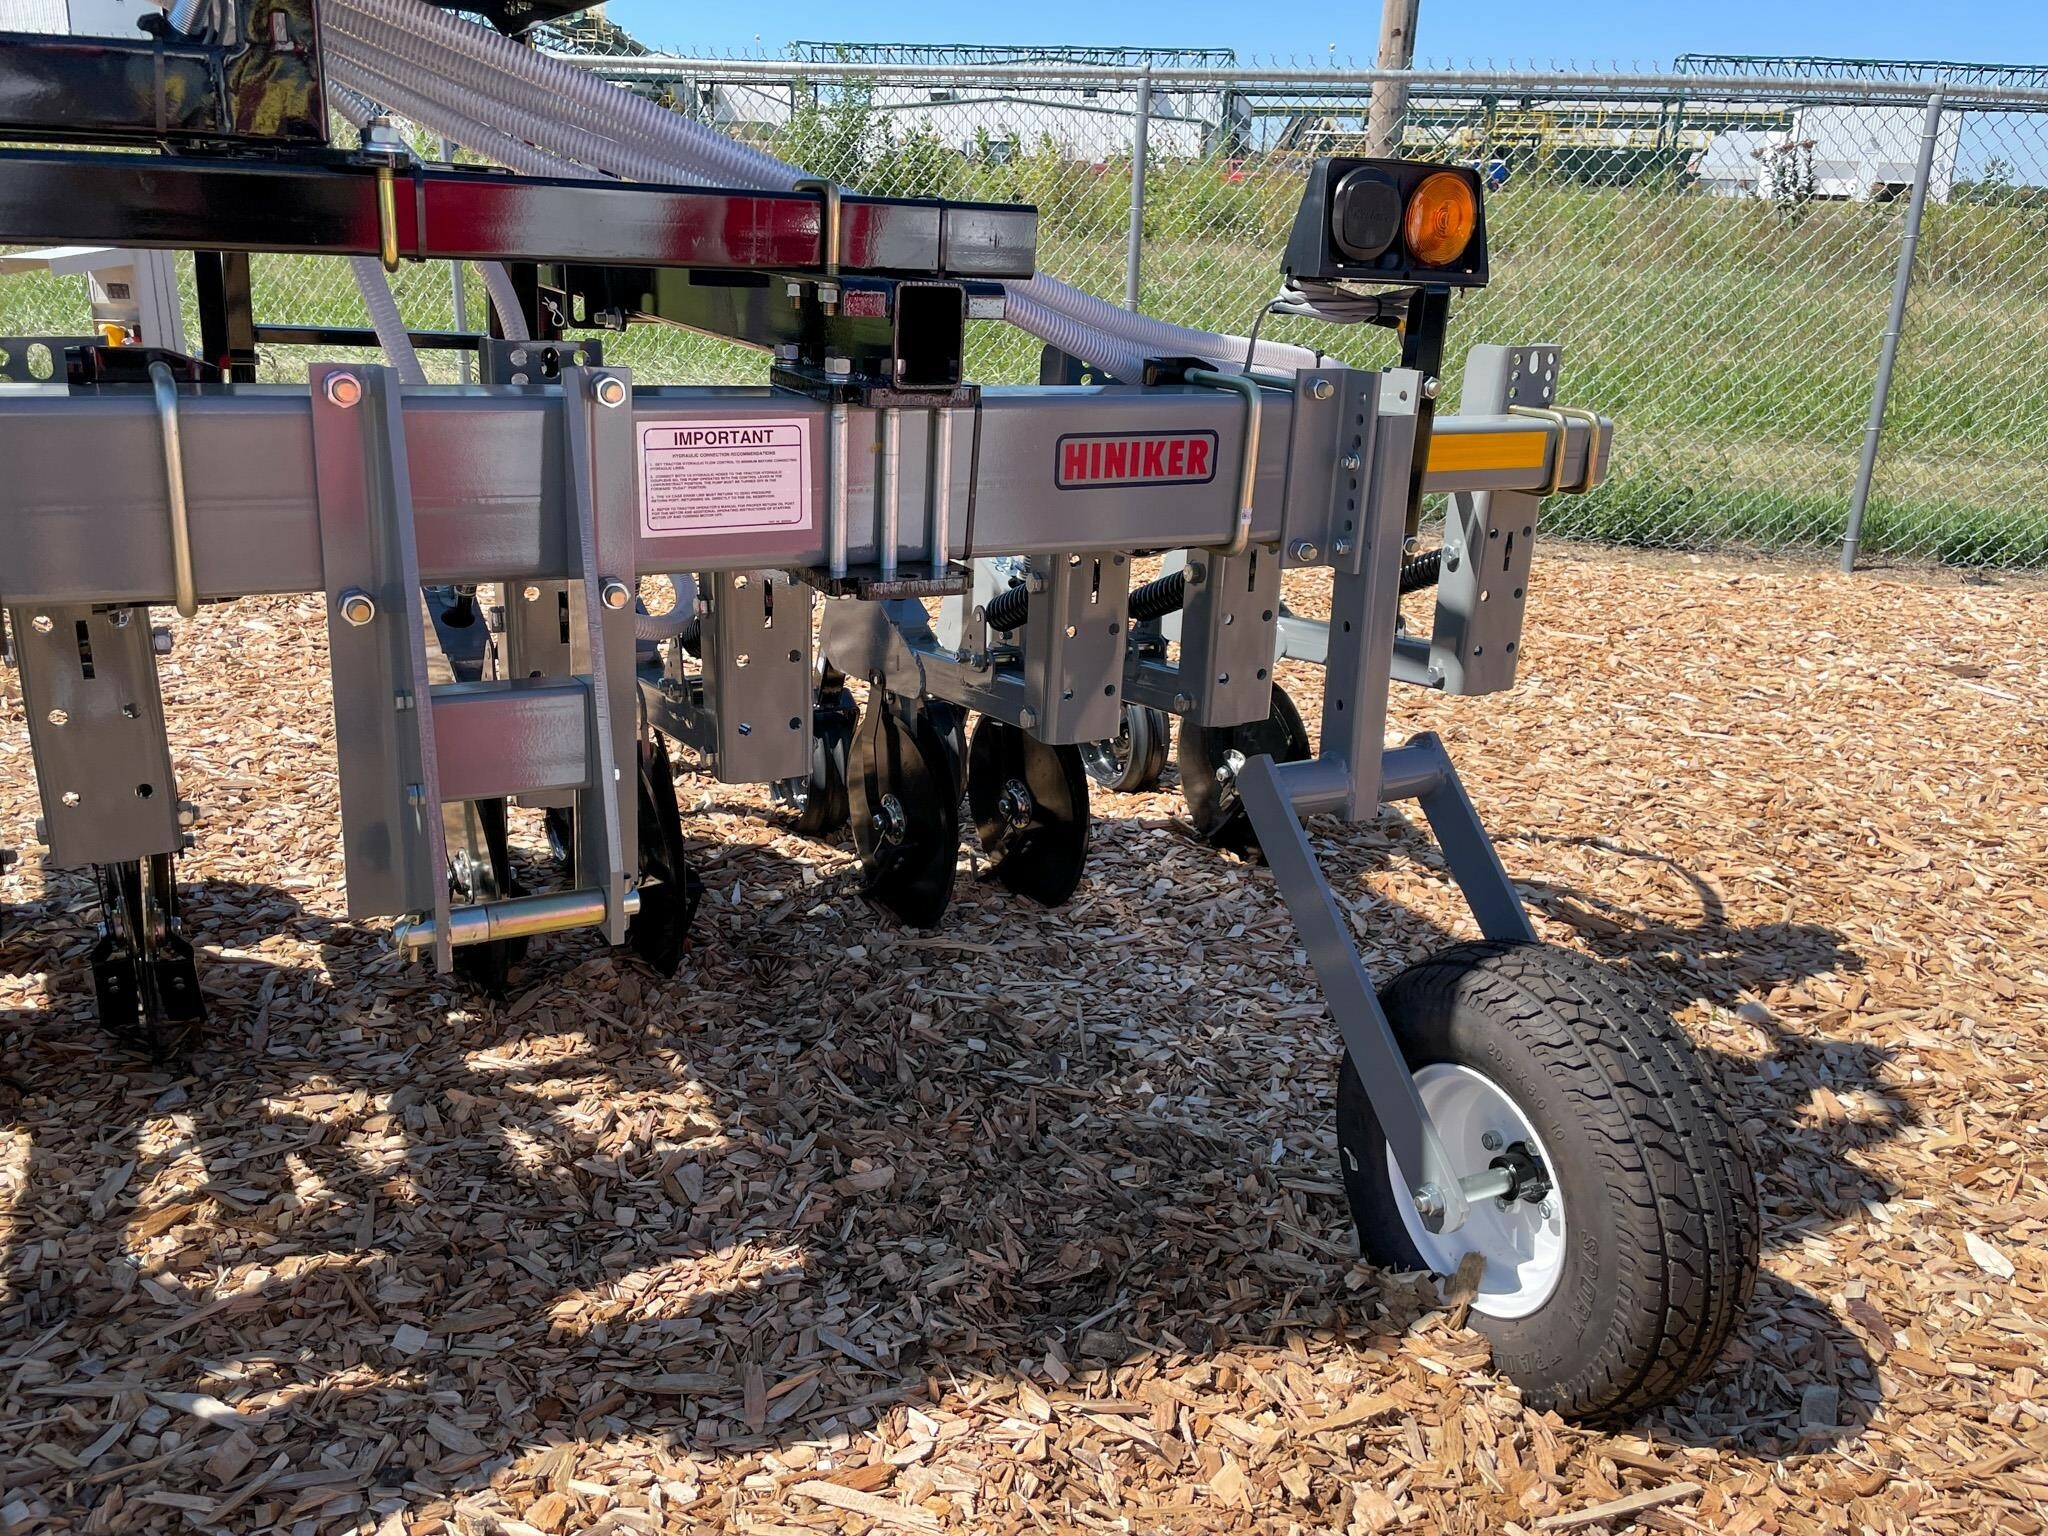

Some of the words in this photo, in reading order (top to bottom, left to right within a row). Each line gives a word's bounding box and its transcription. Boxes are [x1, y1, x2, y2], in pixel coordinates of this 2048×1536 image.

[674, 430, 774, 446] IMPORTANT
[1063, 439, 1209, 481] HINIKER
[1487, 1040, 1514, 1072] 20.5
[1569, 1229, 1600, 1348] SPORT
